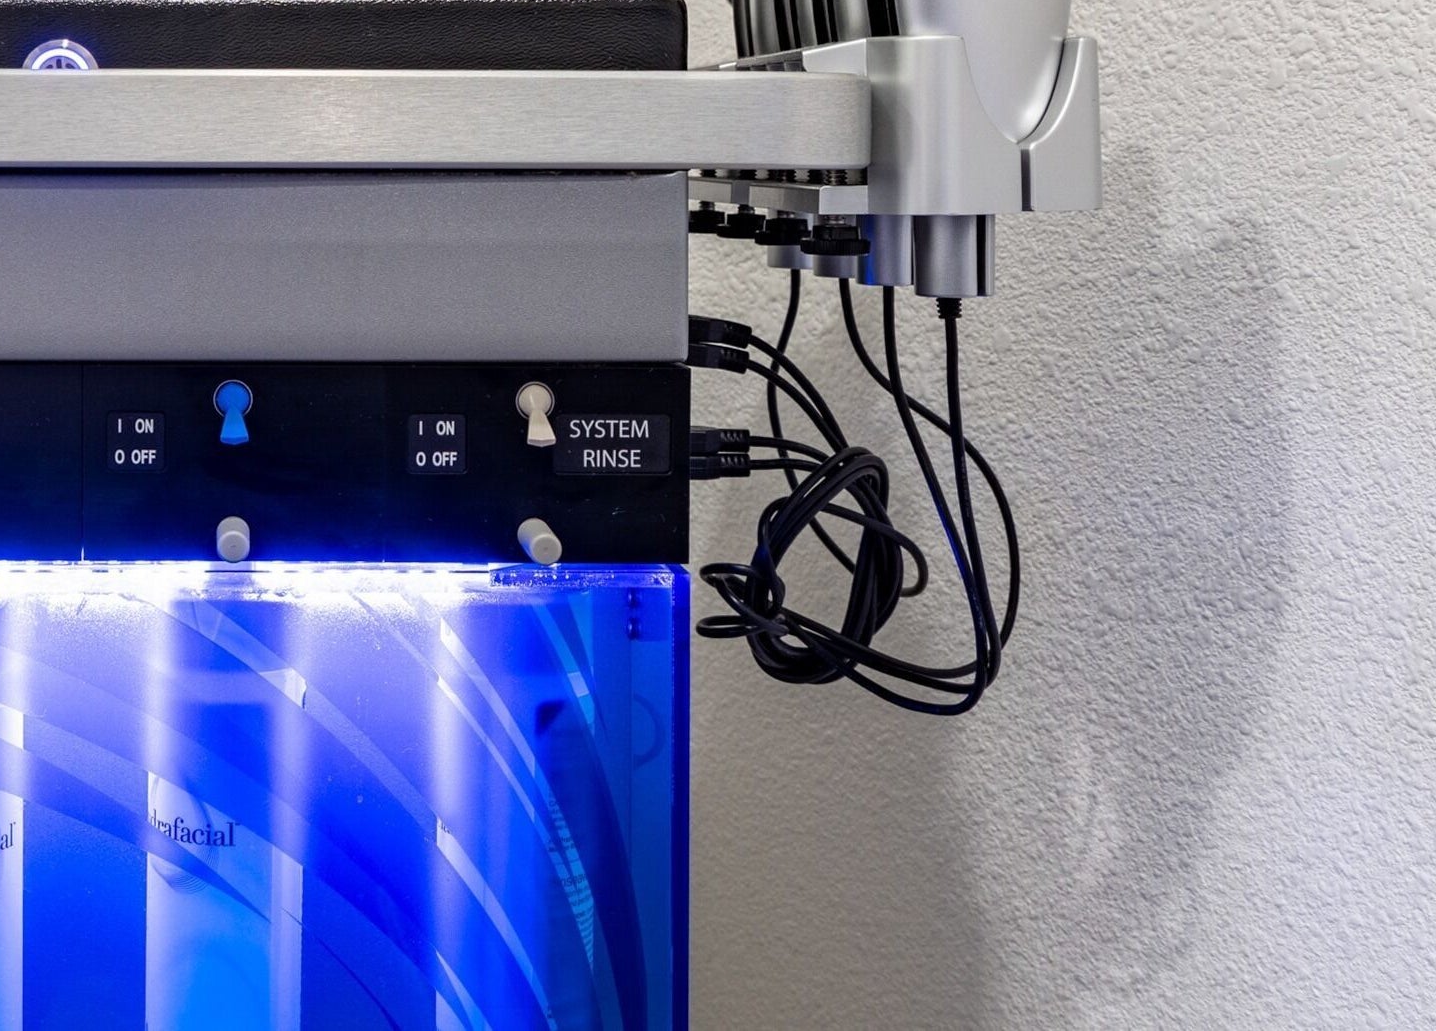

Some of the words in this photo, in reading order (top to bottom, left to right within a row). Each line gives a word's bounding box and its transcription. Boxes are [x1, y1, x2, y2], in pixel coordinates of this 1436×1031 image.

[135, 419, 153, 433] ON
[436, 421, 454, 435] ON
[569, 419, 649, 438] SYSTEM
[131, 450, 157, 464] OFF
[432, 452, 458, 466] OFF
[583, 449, 641, 468] RINSE
